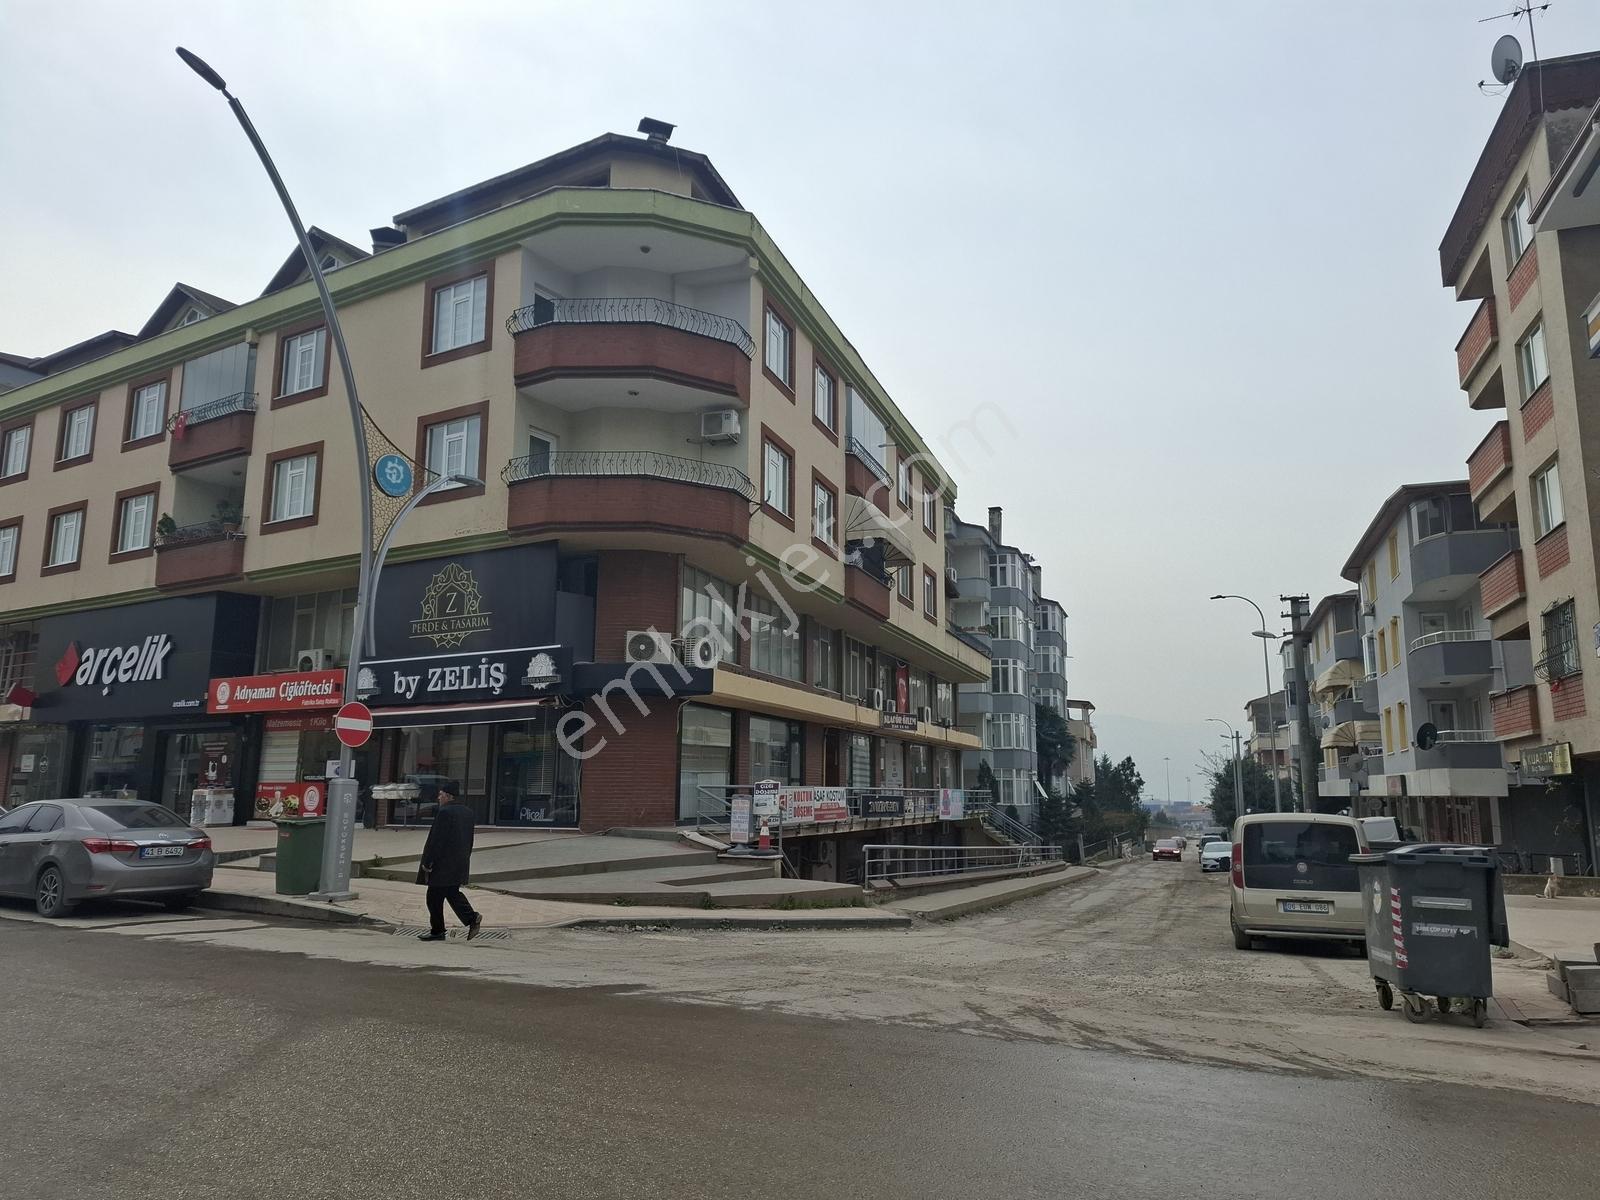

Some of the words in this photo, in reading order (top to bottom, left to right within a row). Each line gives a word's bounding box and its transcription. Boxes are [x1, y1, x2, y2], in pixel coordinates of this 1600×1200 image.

[446, 592, 457, 613] Z
[411, 621, 440, 633] PERDE
[441, 621, 448, 631] &
[450, 616, 490, 629] TASARIM
[75, 633, 172, 696] arçelik
[394, 671, 421, 699] by
[427, 657, 507, 695] ZELİŞ
[233, 685, 276, 703] Adıyaman
[279, 679, 334, 701] Çiğköftecisi
